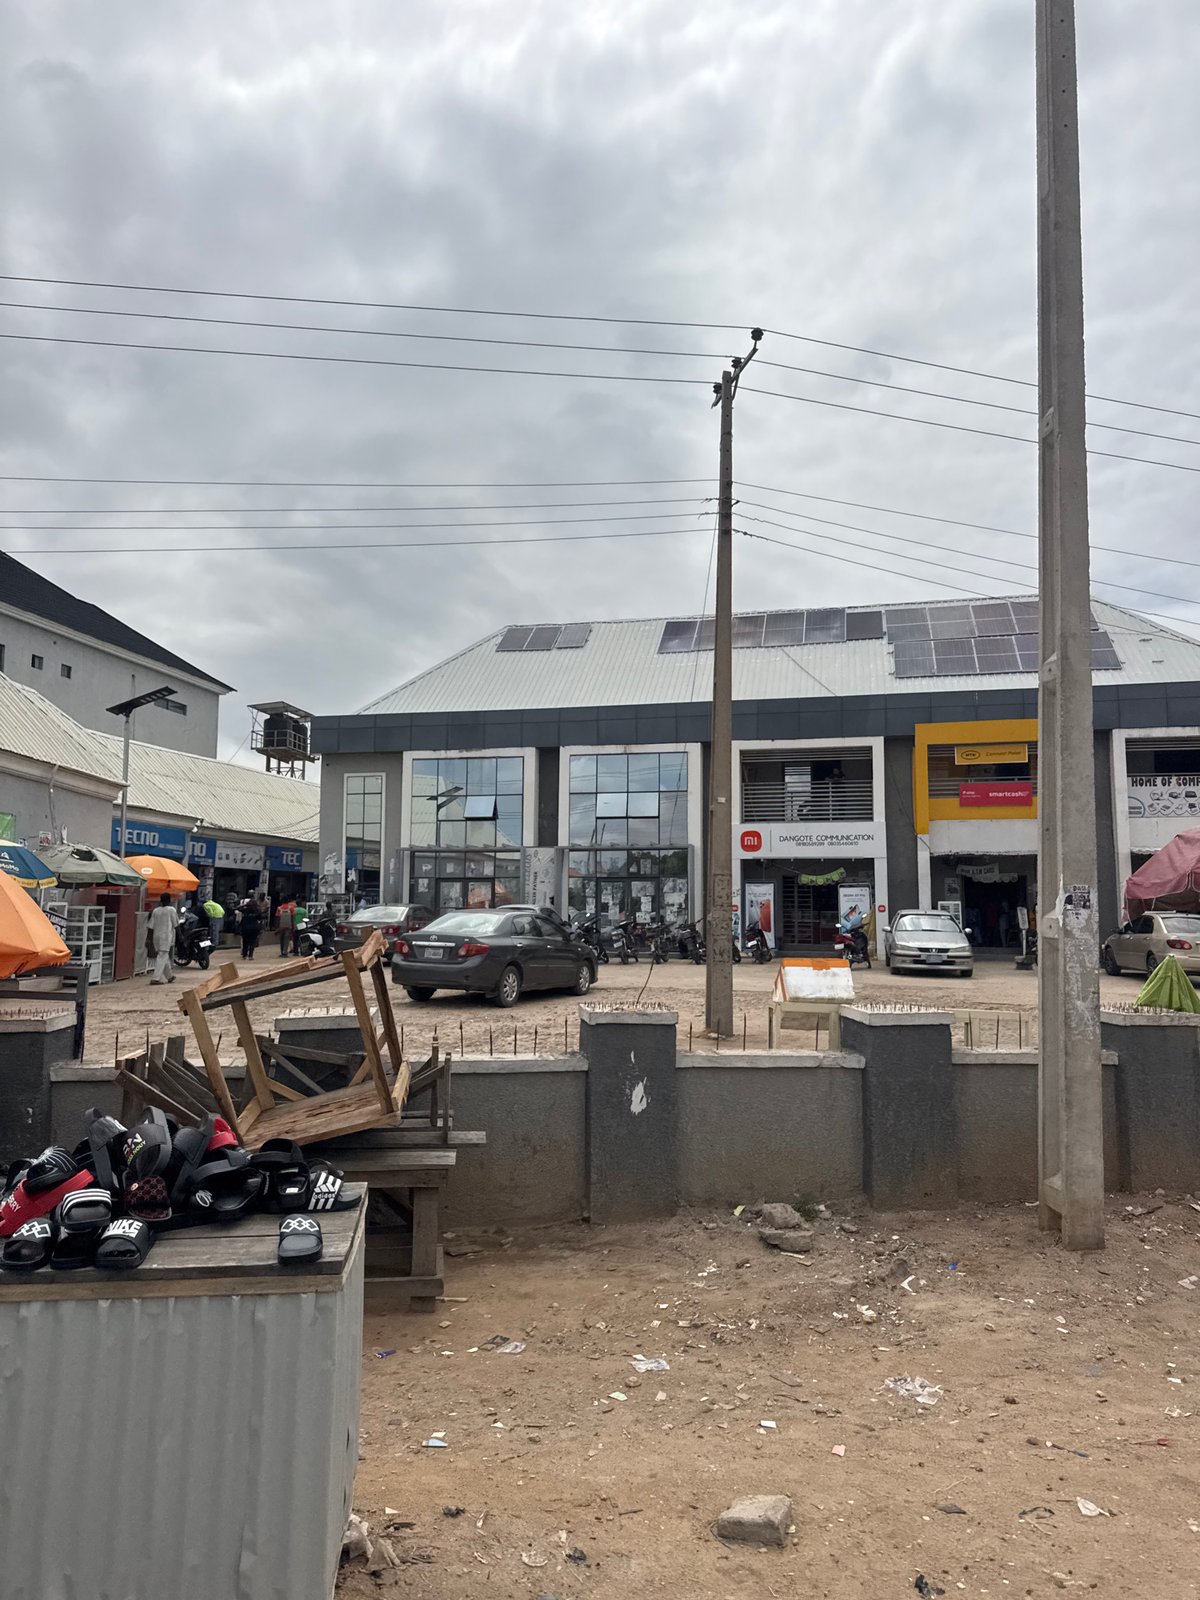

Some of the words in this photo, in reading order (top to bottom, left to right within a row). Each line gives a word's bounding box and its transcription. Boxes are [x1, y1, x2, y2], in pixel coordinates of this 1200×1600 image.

[1131, 777, 1158, 787] HOME
[1161, 777, 1172, 787] OF
[115, 827, 159, 847] TECNO
[281, 851, 300, 866] TEC
[313, 1192, 336, 1200] adidas
[104, 1219, 143, 1236] NIKE
